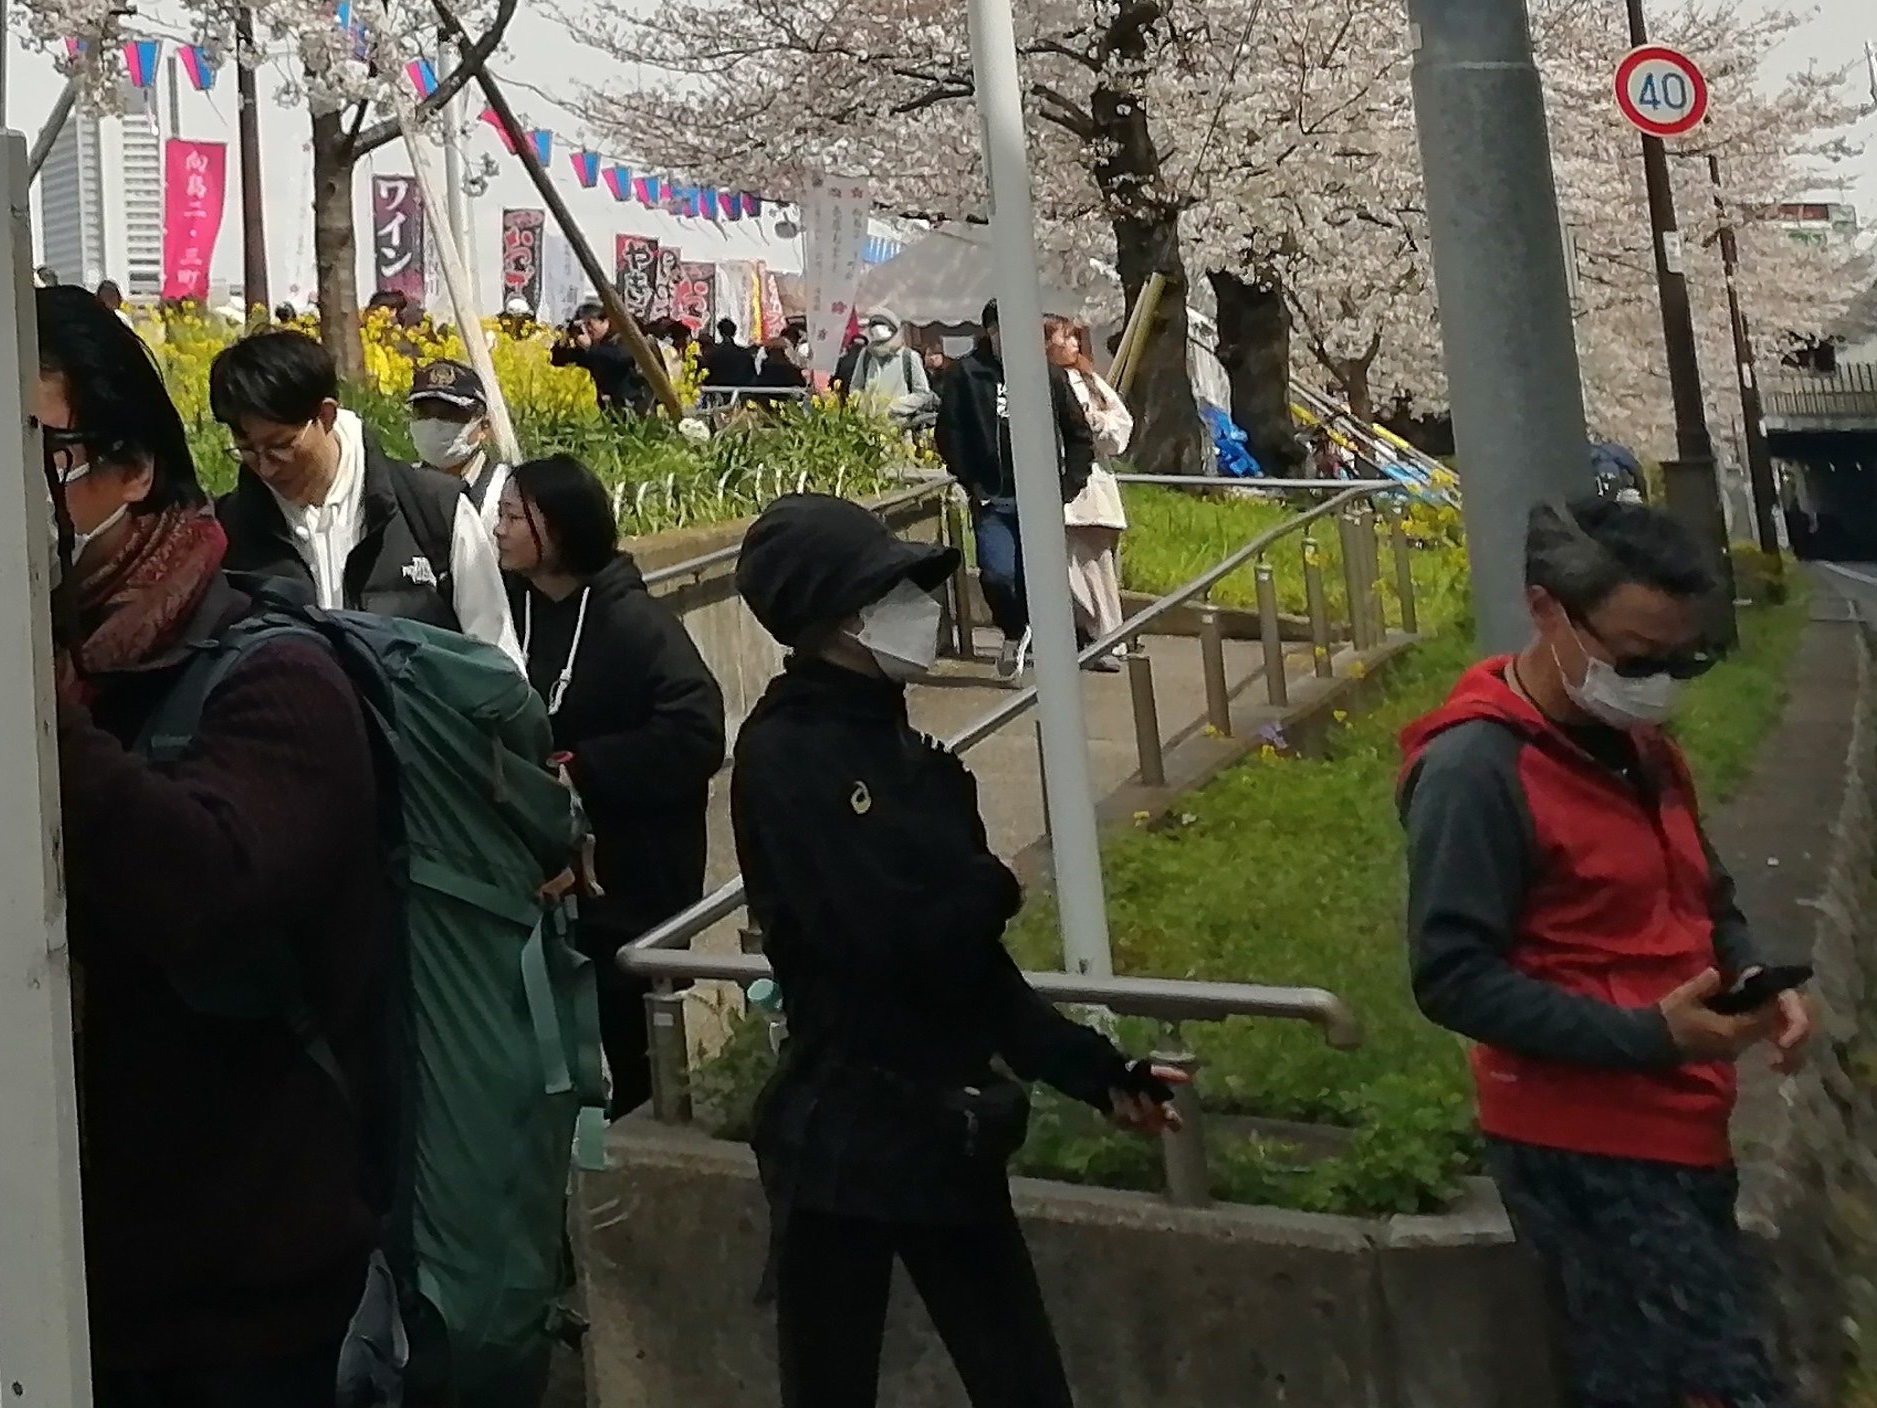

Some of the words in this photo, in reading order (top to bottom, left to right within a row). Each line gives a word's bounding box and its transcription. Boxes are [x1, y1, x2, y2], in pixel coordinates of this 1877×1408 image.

[1638, 71, 1688, 111] 40
[376, 178, 413, 279] ワイン
